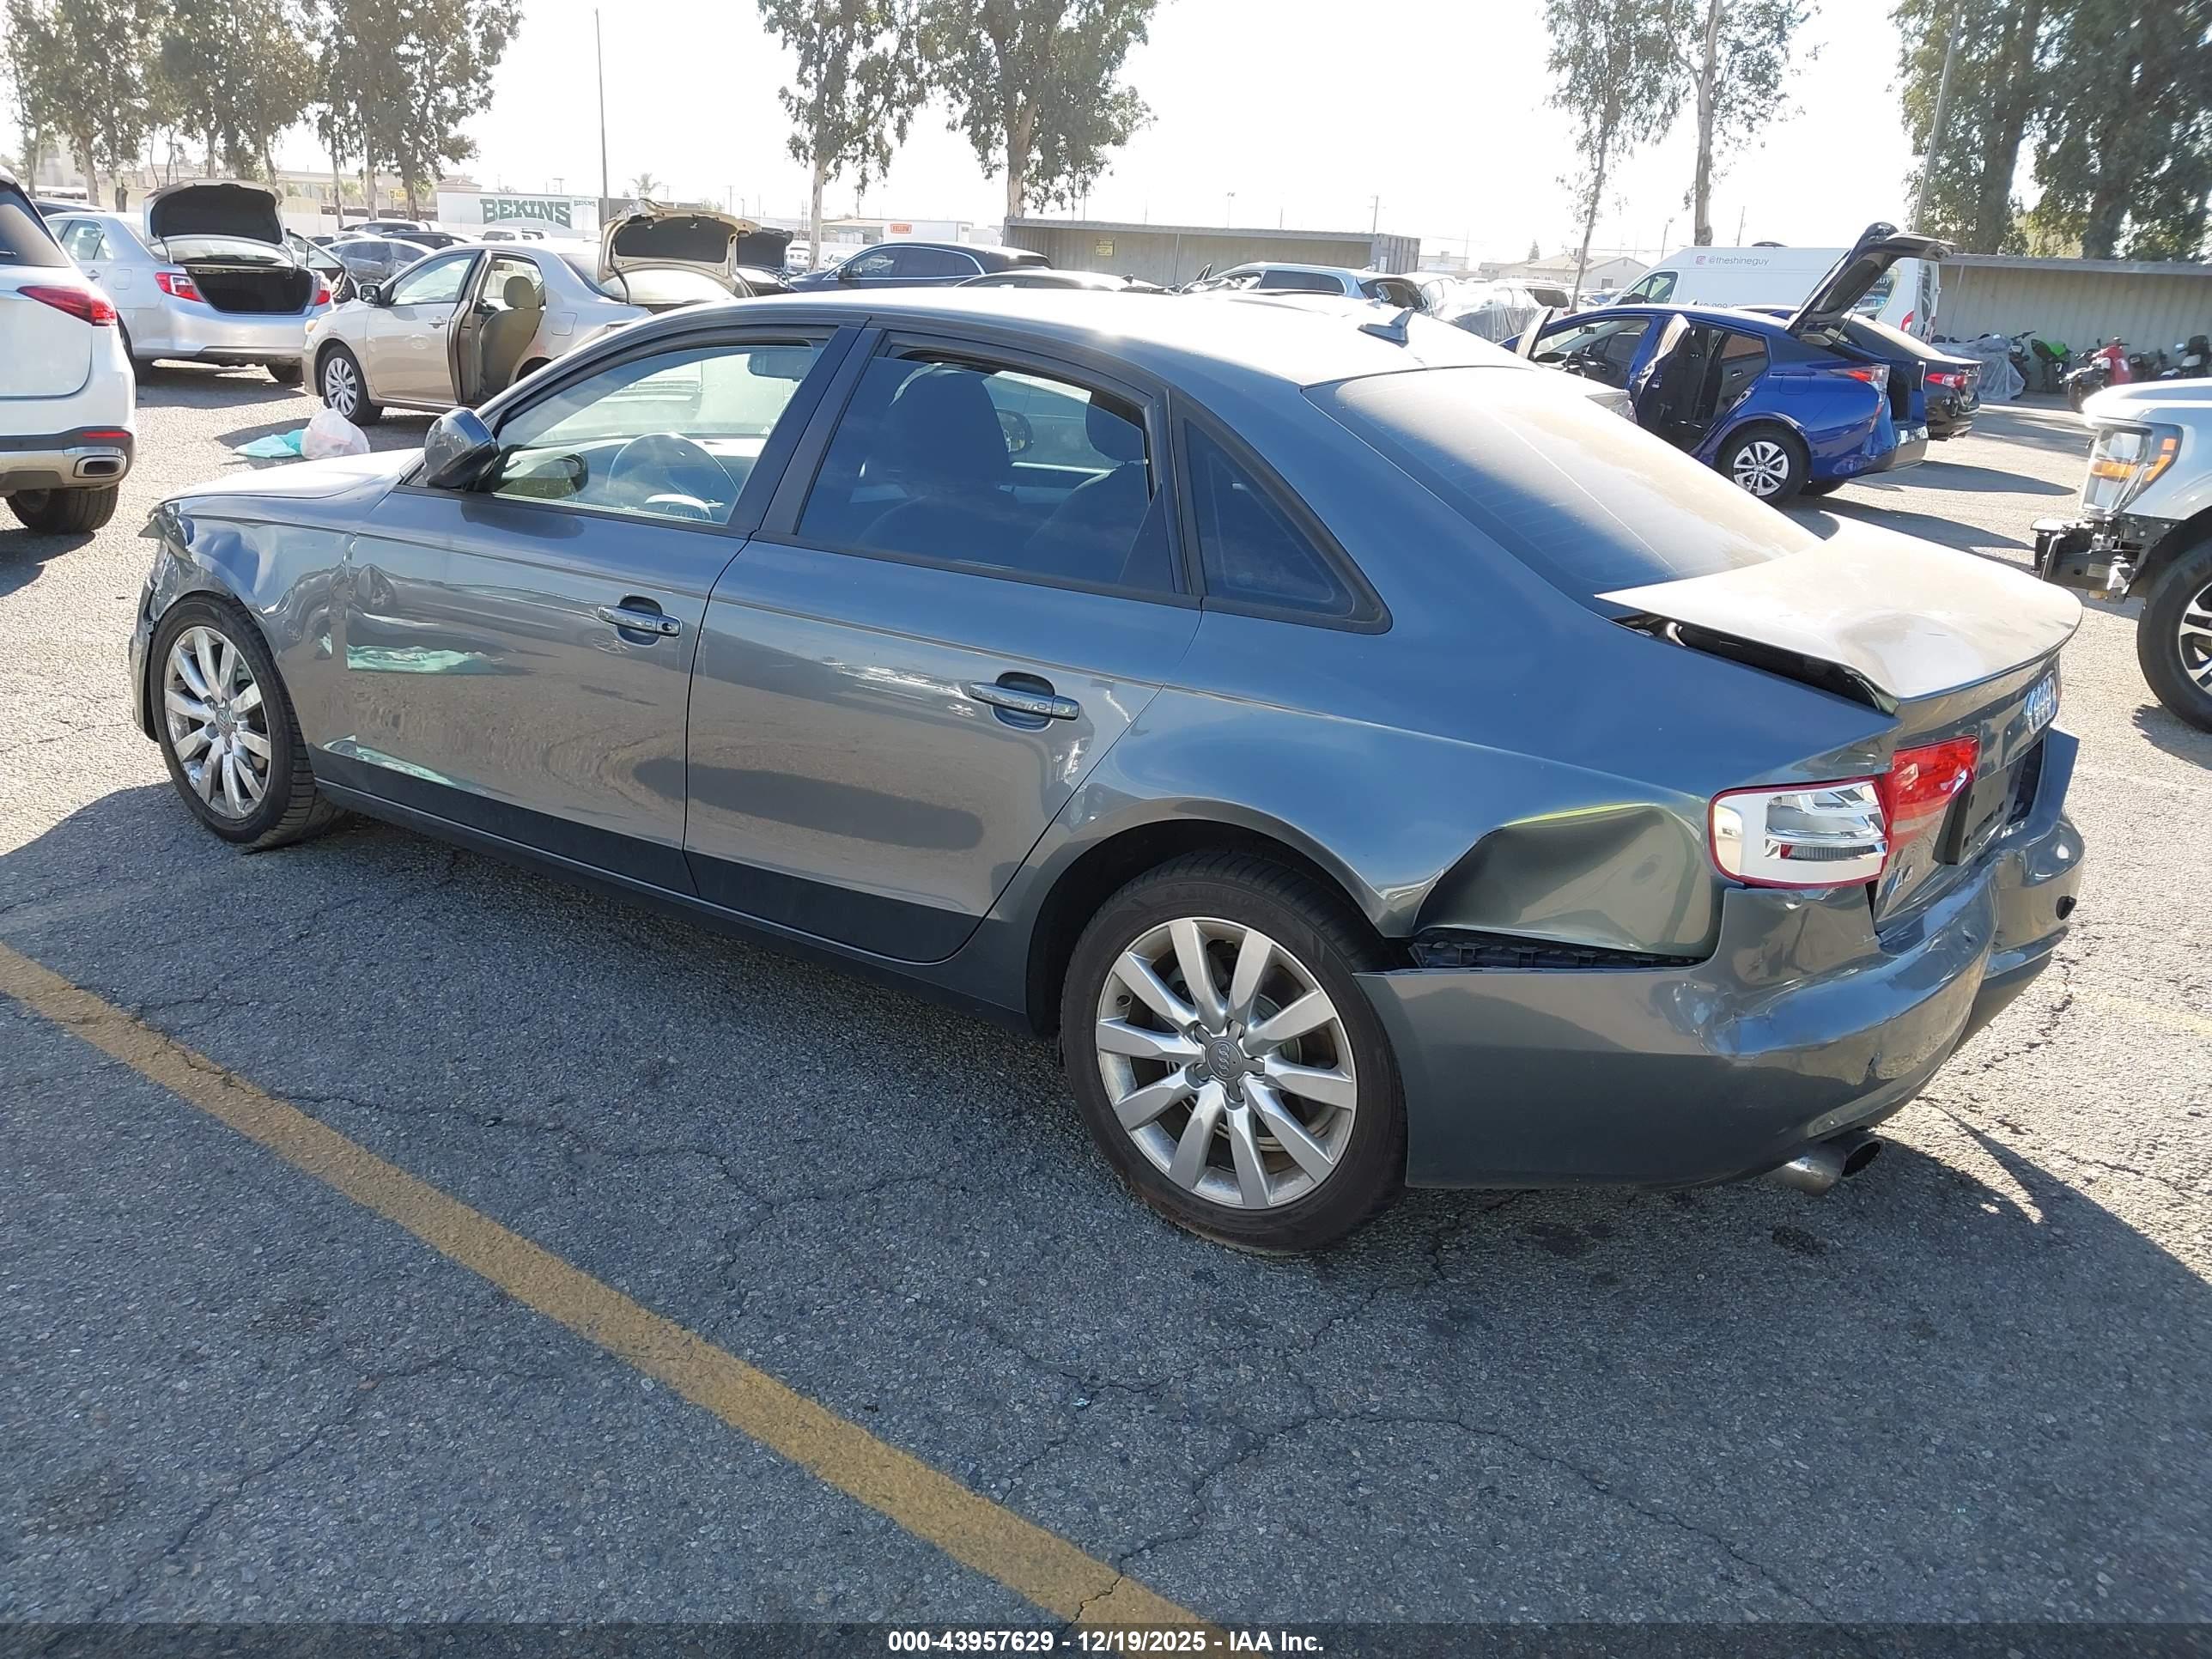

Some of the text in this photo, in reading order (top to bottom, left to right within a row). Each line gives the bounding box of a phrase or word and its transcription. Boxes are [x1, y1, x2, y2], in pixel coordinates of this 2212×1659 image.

[480, 198, 571, 229] BEKINS
[1709, 257, 1770, 266] @theshineguy
[1889, 865, 1913, 896] A4
